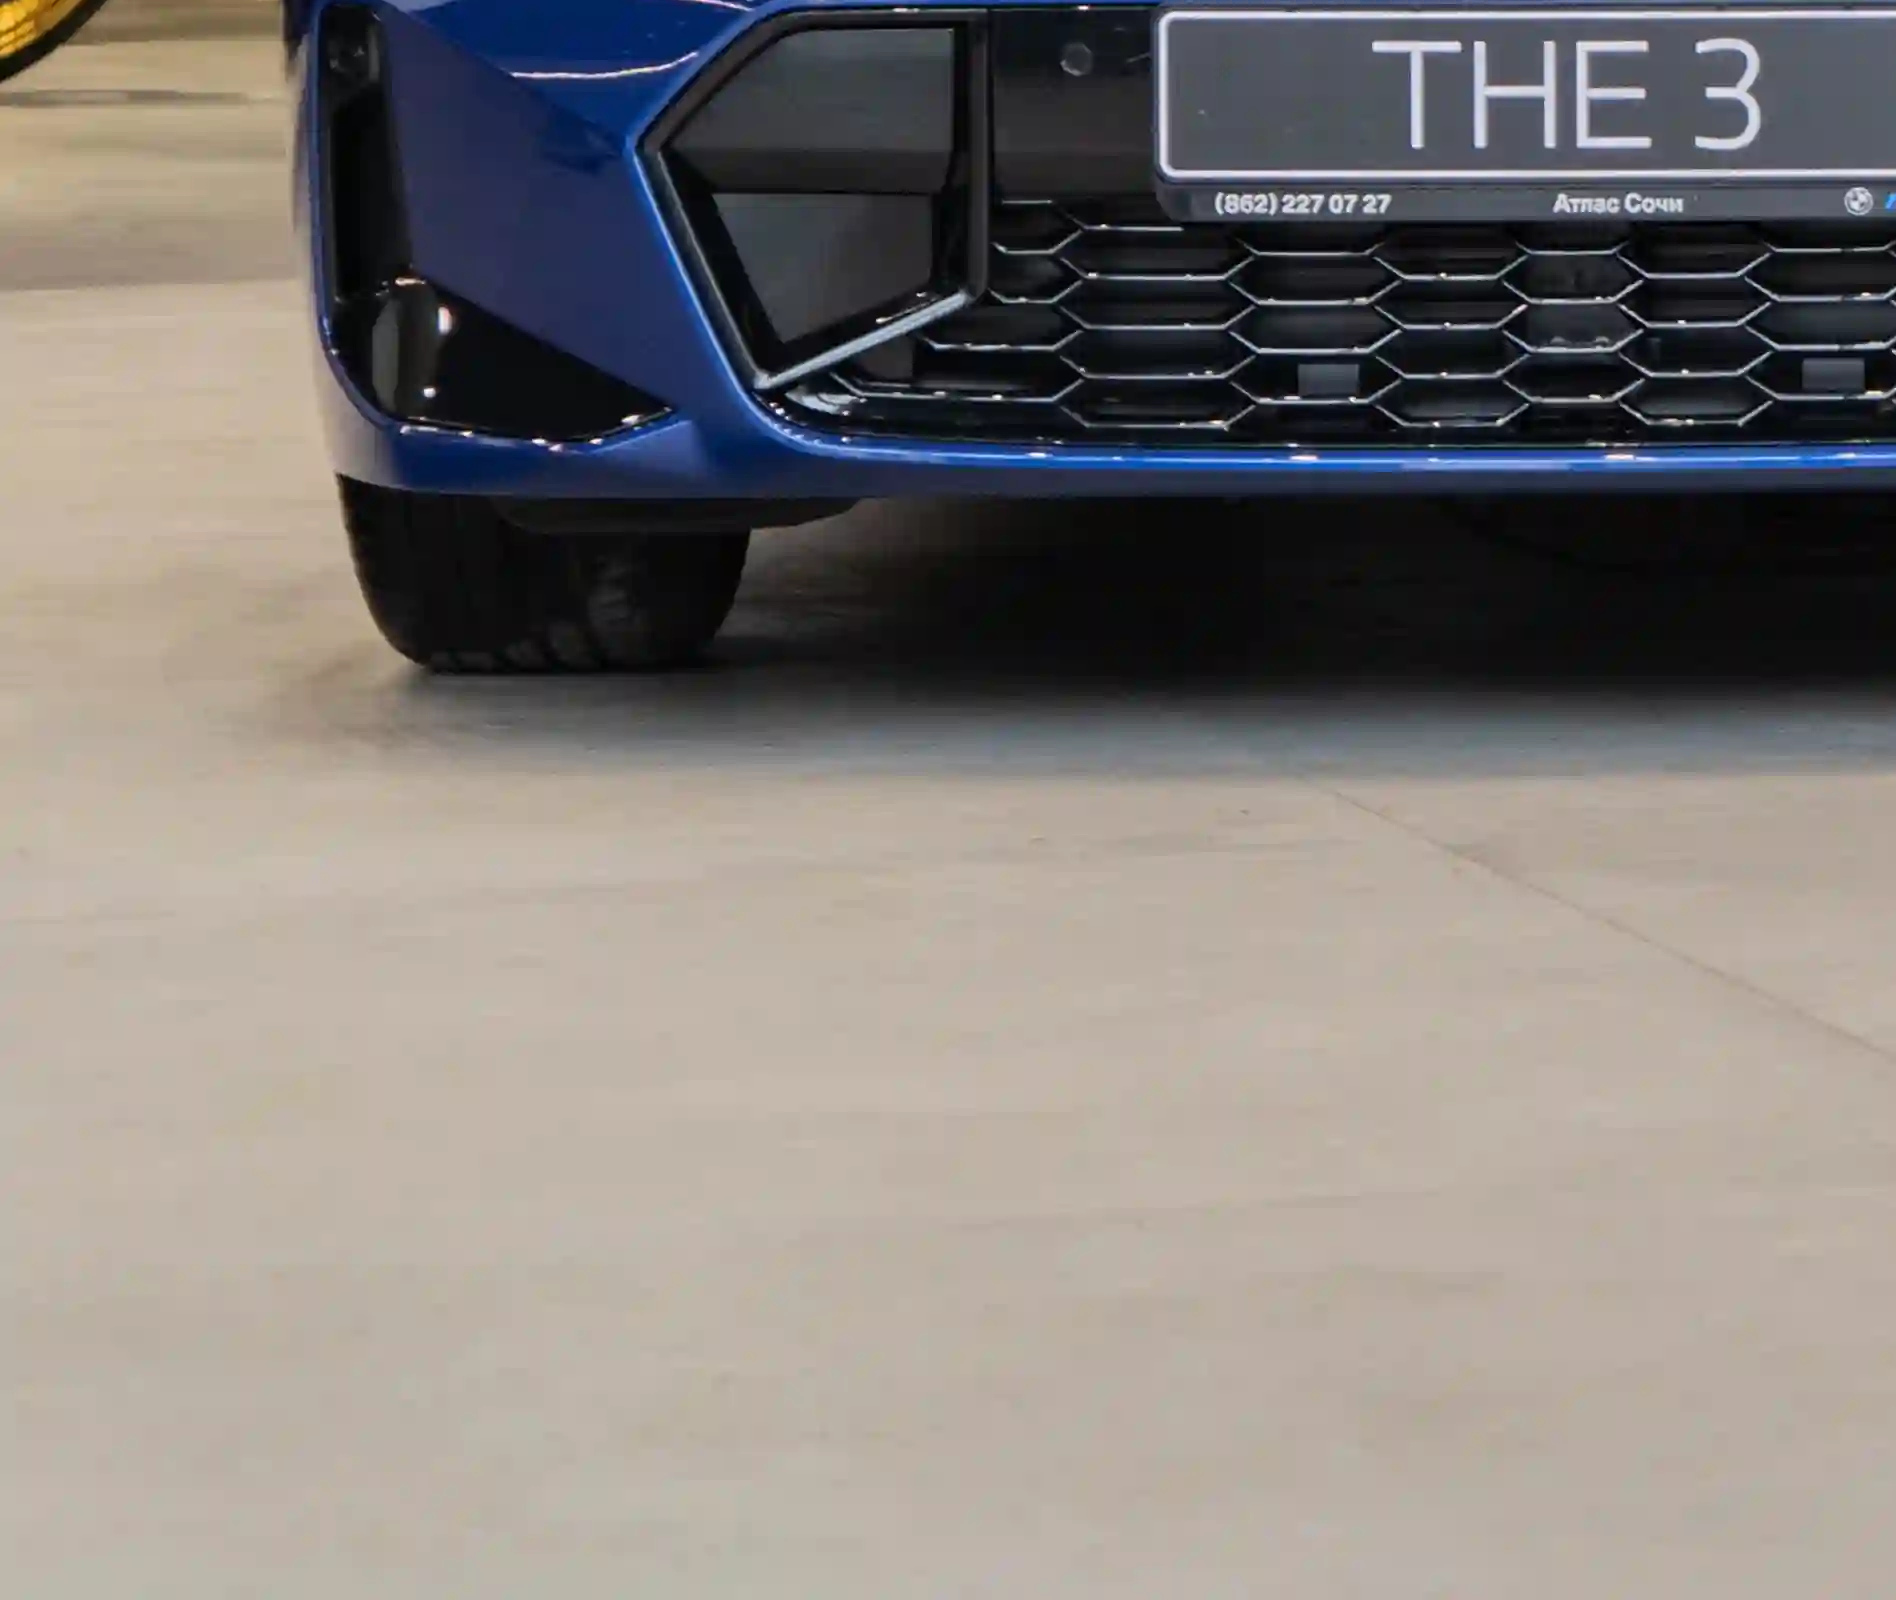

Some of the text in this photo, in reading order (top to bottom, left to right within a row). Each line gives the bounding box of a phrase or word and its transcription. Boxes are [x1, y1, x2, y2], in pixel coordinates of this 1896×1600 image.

[1371, 37, 1762, 151] THE 3
[1214, 191, 1392, 216] (862) 227 07 27
[1624, 192, 1684, 213] Сочи
